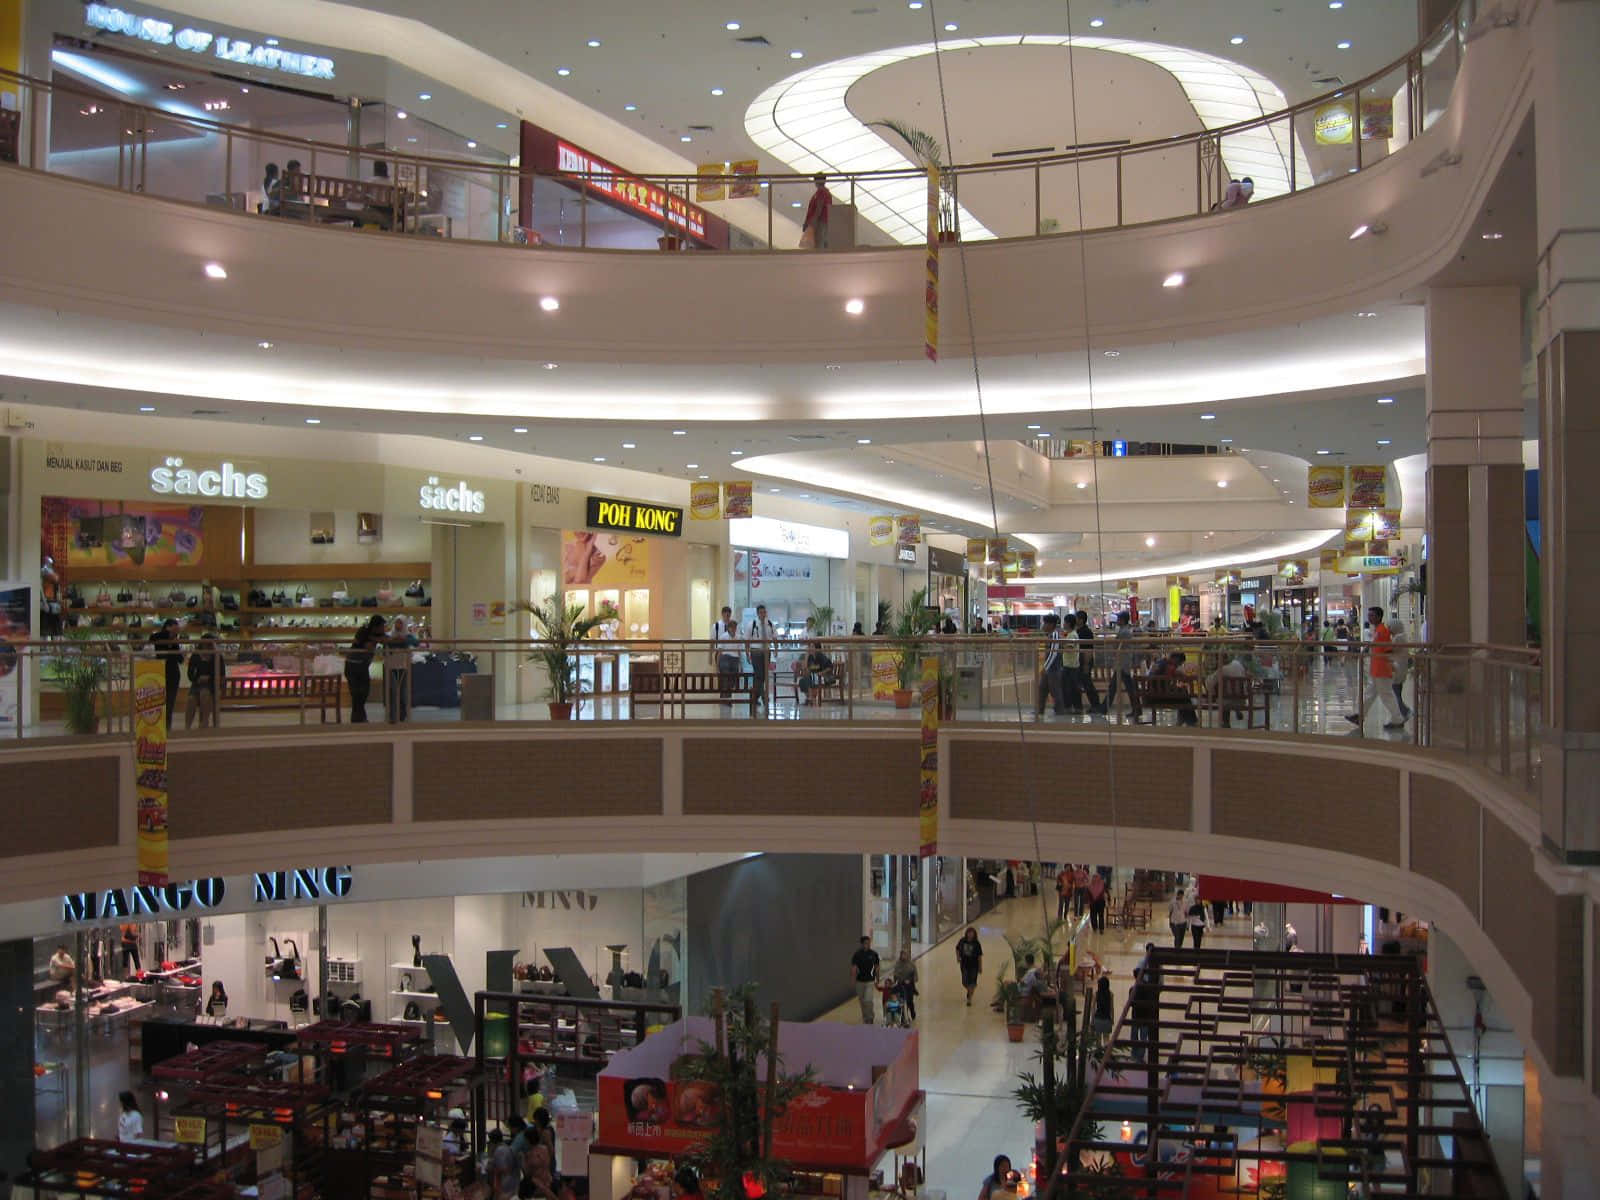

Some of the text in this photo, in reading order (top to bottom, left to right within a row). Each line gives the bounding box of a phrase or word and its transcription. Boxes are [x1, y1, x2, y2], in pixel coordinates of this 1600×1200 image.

[86, 3, 336, 79] HOUSE OF LEATHER
[46, 456, 123, 473] MENJUAL KASUT DAN BEG
[597, 502, 676, 532] POH KONG
[63, 866, 352, 923] MANGO MNG
